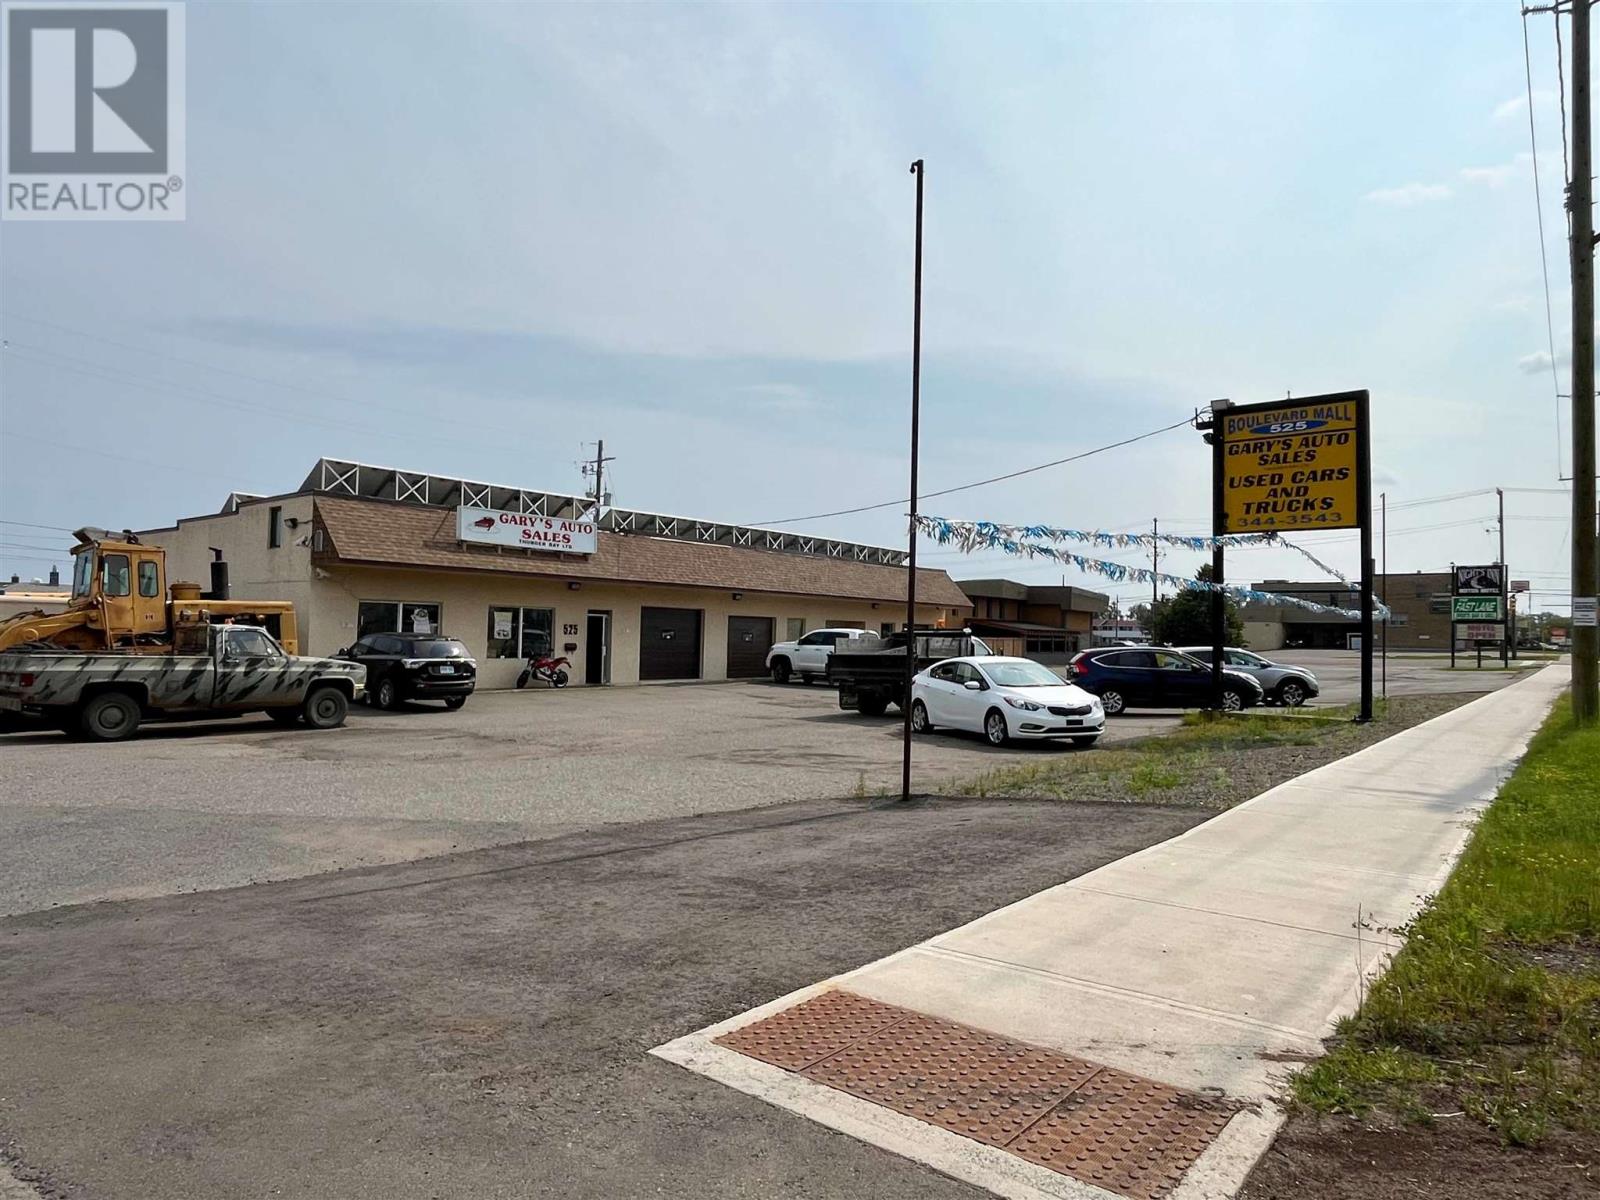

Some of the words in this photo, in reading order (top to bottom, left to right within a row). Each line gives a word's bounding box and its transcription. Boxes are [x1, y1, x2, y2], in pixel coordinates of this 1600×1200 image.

[1228, 410, 1308, 434] BOULEVARD
[1313, 404, 1352, 421] MALL
[1270, 421, 1307, 433] 525
[1228, 438, 1293, 456] GARY'S
[1298, 432, 1350, 449] AUTO
[1258, 449, 1317, 466] SALES
[1229, 473, 1283, 488] USED
[1291, 467, 1350, 484] CARS
[1265, 485, 1309, 499] AND
[1243, 497, 1335, 515] TRUCKS
[499, 513, 553, 529] GARY'S
[560, 521, 593, 534] AUTO
[1237, 512, 1342, 527] 344-3543
[522, 529, 571, 544] SALES
[1455, 602, 1475, 611] FAST
[1474, 602, 1496, 611] LANE
[563, 624, 578, 635] 525
